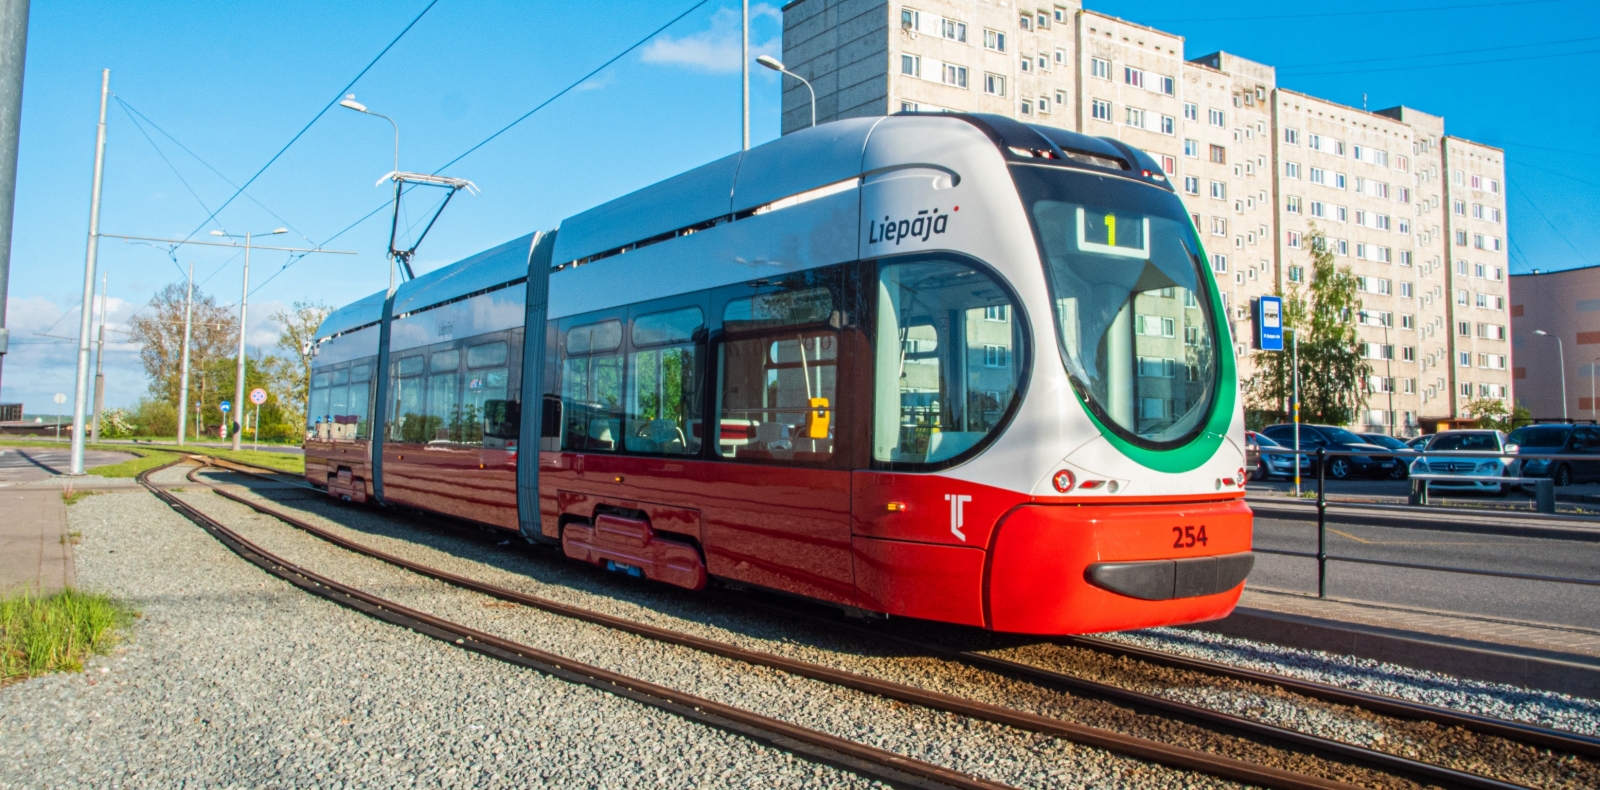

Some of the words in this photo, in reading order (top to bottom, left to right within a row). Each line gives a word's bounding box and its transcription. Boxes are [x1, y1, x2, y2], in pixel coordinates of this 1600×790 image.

[869, 207, 948, 246] Liepāja
[1104, 214, 1115, 247] 1
[1172, 525, 1208, 548] 254
